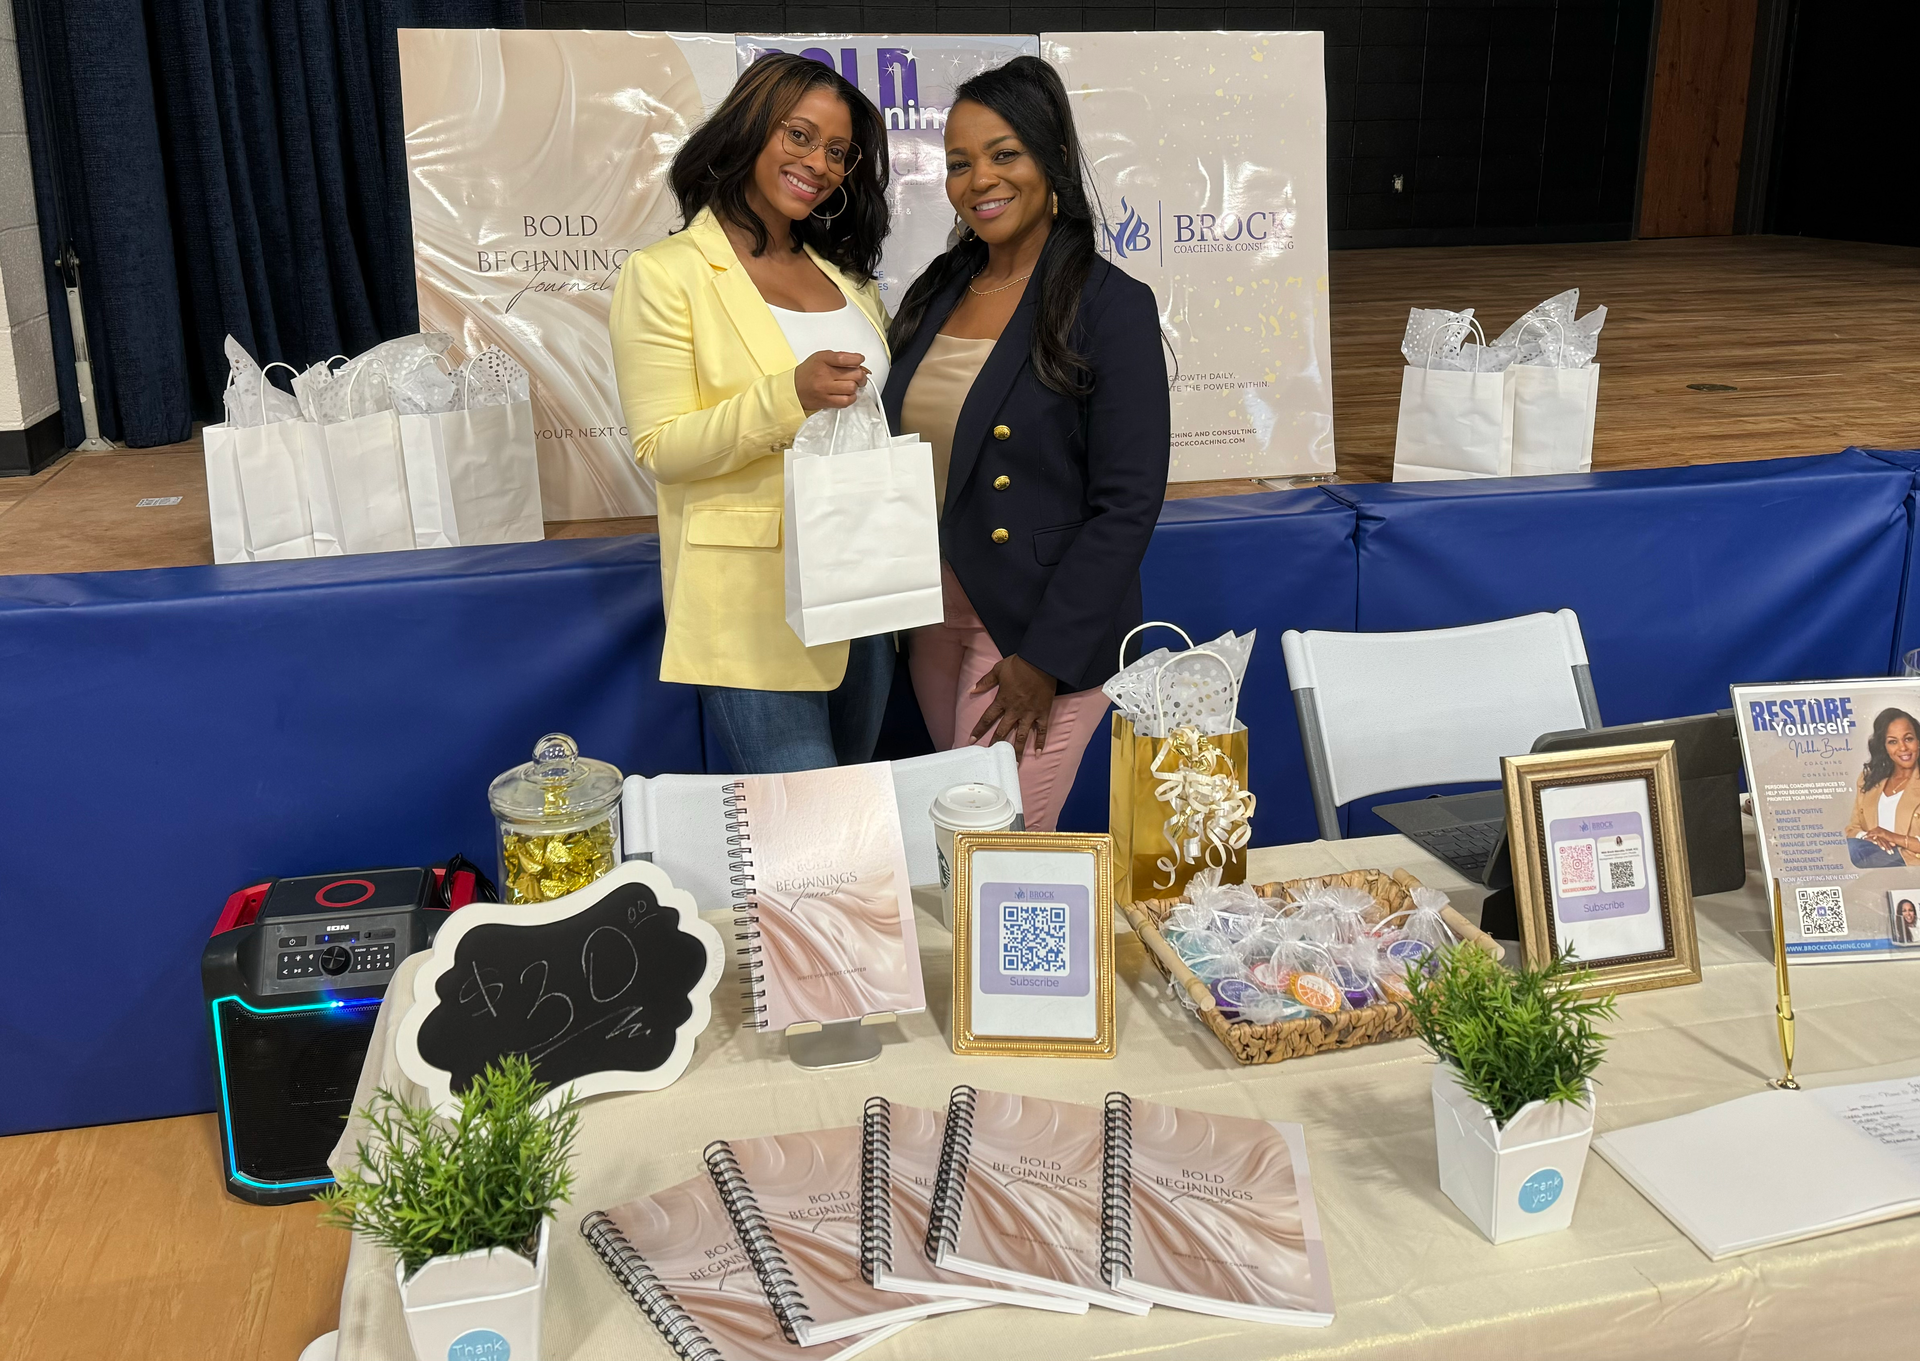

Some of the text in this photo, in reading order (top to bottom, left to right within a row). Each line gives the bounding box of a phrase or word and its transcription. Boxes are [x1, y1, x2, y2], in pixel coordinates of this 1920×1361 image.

[523, 215, 598, 237] BOLD
[1173, 211, 1293, 243] BROCK
[1173, 240, 1294, 254] COACHING & CONSUNG
[477, 249, 641, 273] BEGINNING
[505, 260, 622, 314] Journal
[1168, 372, 1236, 382] GROWTH DAILY.
[1203, 383, 1235, 391] POWER
[1237, 381, 1270, 389] WITHIN.
[533, 429, 574, 440] YOUR
[578, 427, 615, 437] NEXT
[1211, 428, 1257, 437] CONSULTING
[1749, 697, 1856, 731] RESTORE
[1772, 718, 1850, 737] Yourself
[1592, 821, 1614, 830] BROCK
[776, 871, 858, 892] BEGINNINGS
[1029, 891, 1055, 899] BROCK
[1583, 901, 1625, 913] Subscribe
[1785, 943, 1872, 953] WWW.BROCKCOACHING.COM
[1009, 976, 1060, 988] Subscribe
[1020, 1155, 1062, 1171] BOLD
[993, 1162, 1087, 1189] BEGINNINGS
[1182, 1169, 1224, 1184] BOLD
[1156, 1176, 1253, 1201] BEGINNINGS
[1525, 1176, 1561, 1192] Thank
[808, 1191, 851, 1204] BOLD
[1532, 1191, 1553, 1208] you
[452, 1338, 503, 1357] Thank
